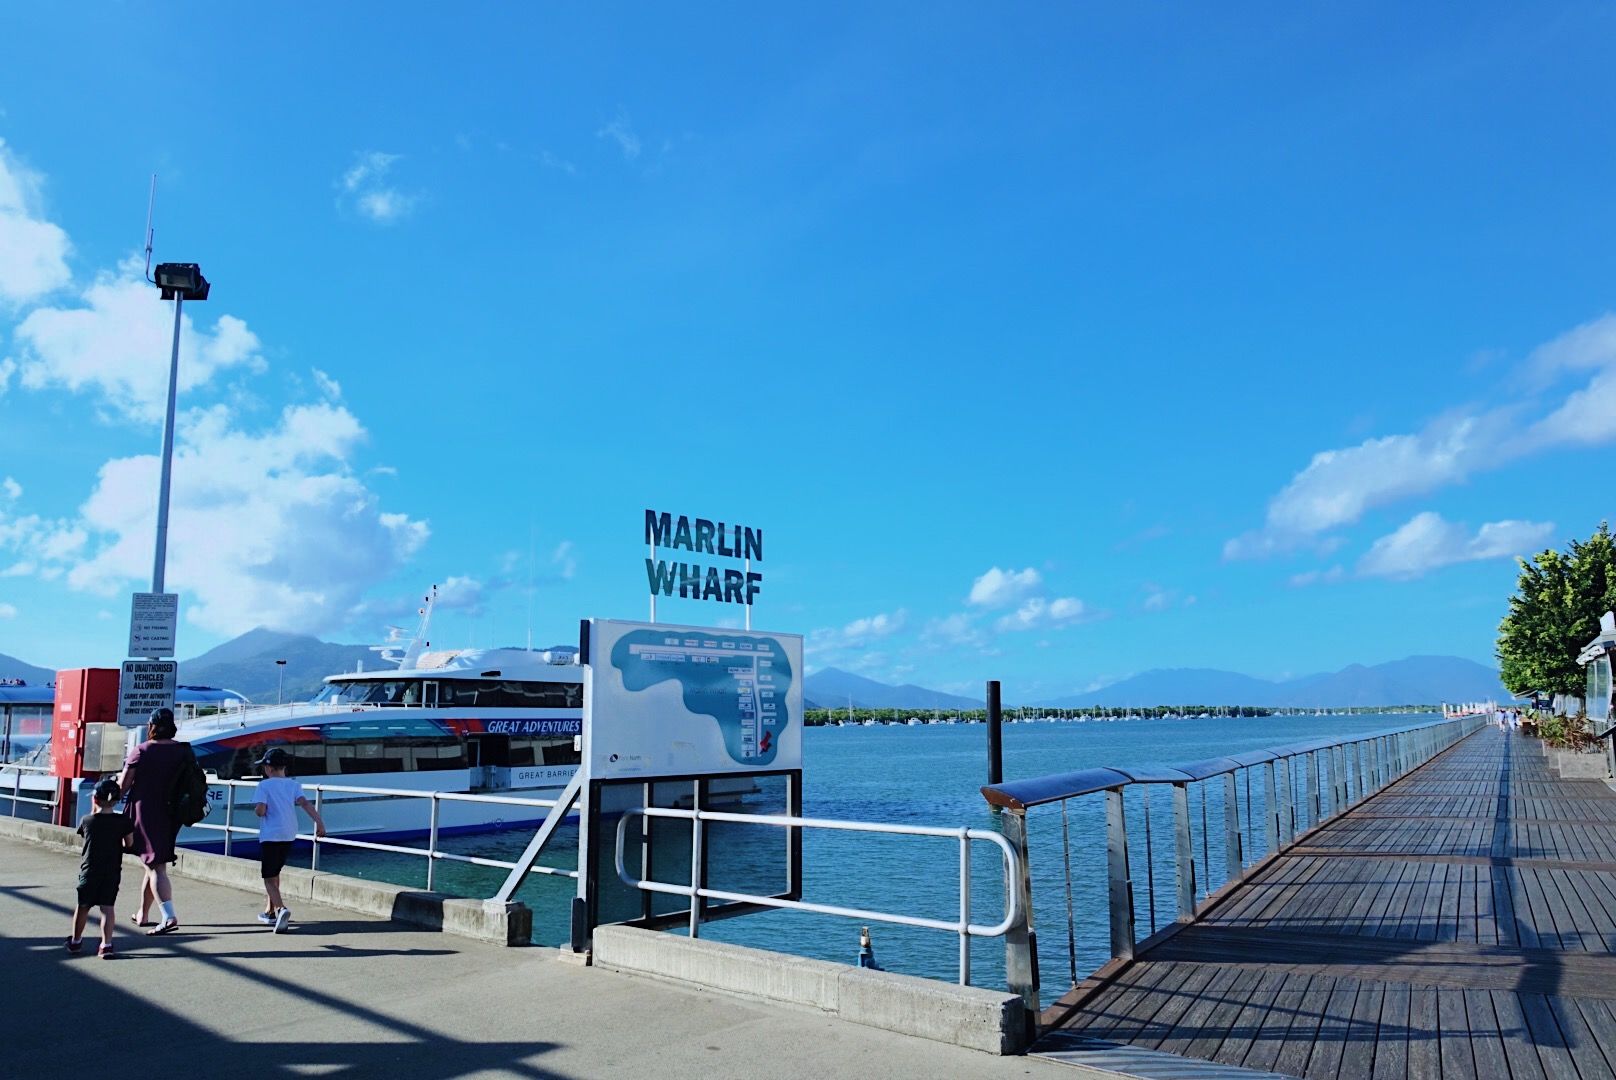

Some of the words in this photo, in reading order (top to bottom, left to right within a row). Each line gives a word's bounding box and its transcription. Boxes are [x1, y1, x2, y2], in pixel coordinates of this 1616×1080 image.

[645, 509, 762, 561] MARLIN
[645, 558, 762, 605] WHARF
[126, 664, 134, 672] NO
[135, 664, 172, 672] UNAUTHORISED
[488, 721, 521, 733] GREAT
[522, 720, 580, 732] ADVENTURES
[519, 772, 543, 780] GREAT
